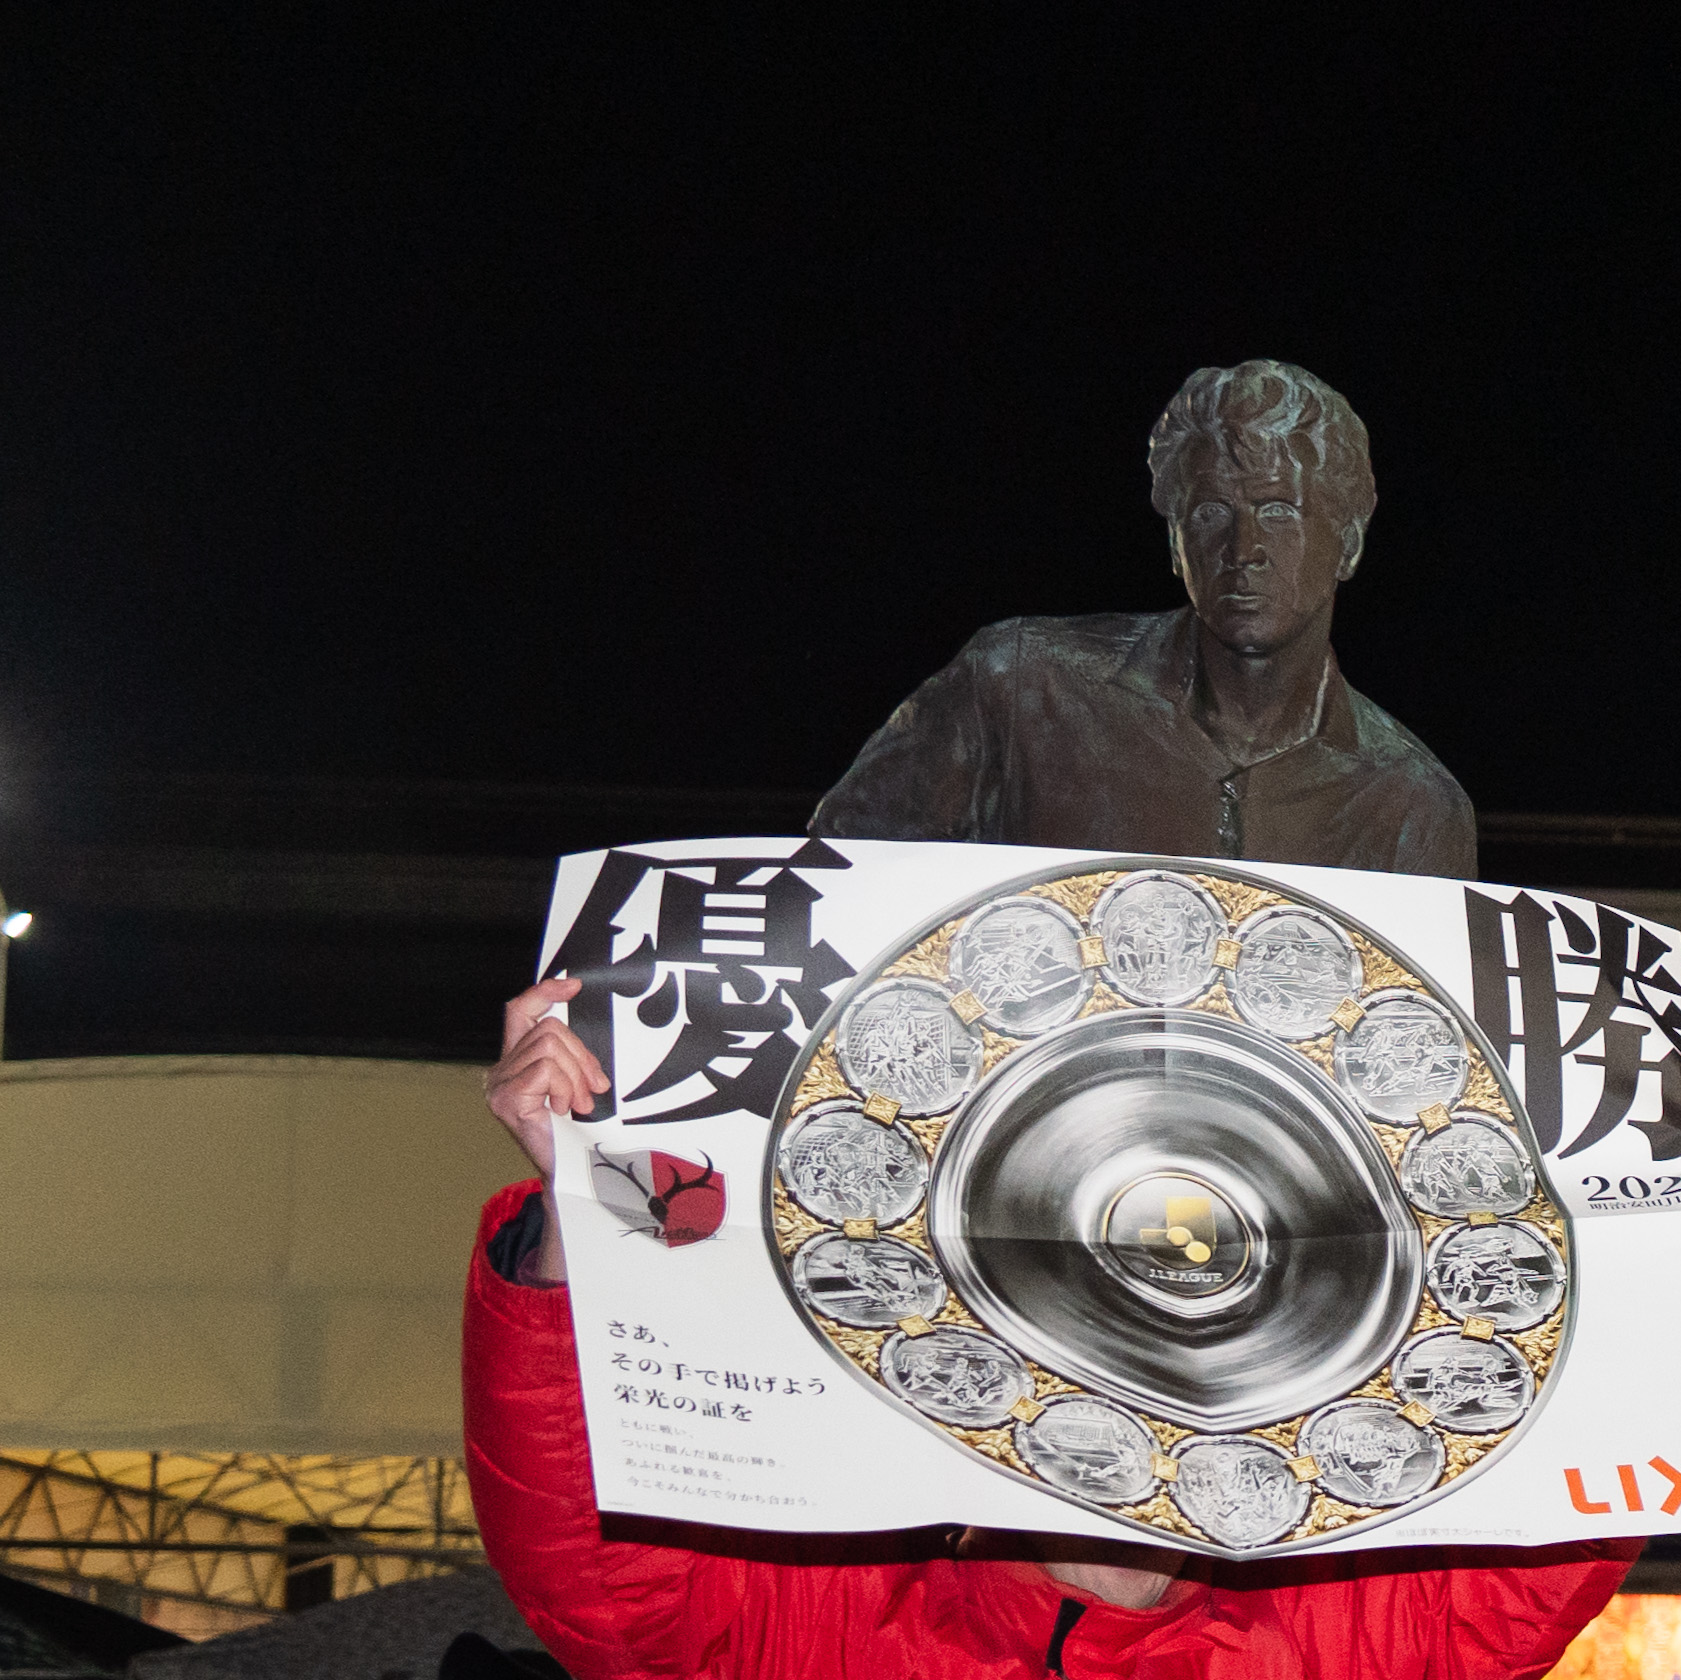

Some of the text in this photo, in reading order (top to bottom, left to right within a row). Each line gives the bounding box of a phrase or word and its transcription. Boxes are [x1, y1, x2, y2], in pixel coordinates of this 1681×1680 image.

[537, 838, 857, 1126] 優
[606, 1319, 671, 1348] さあ、
[610, 1352, 826, 1396] その手で掲げよう
[613, 1382, 753, 1422] 栄光の証を
